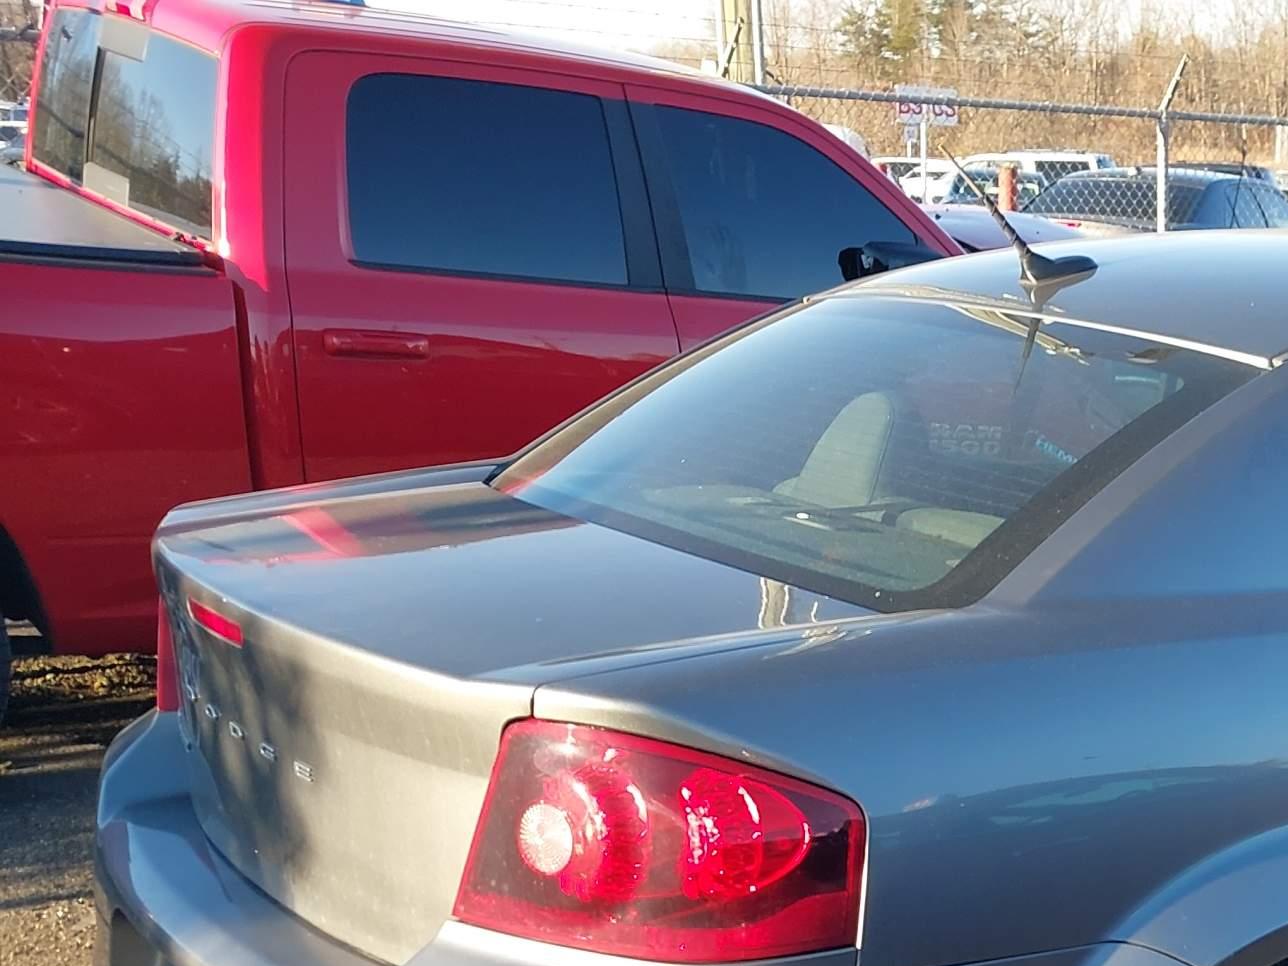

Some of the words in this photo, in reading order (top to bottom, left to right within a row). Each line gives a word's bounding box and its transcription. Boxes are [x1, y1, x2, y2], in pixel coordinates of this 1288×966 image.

[929, 422, 1002, 438] RAM
[929, 439, 1000, 454] 1500
[186, 684, 314, 782] DODGE
